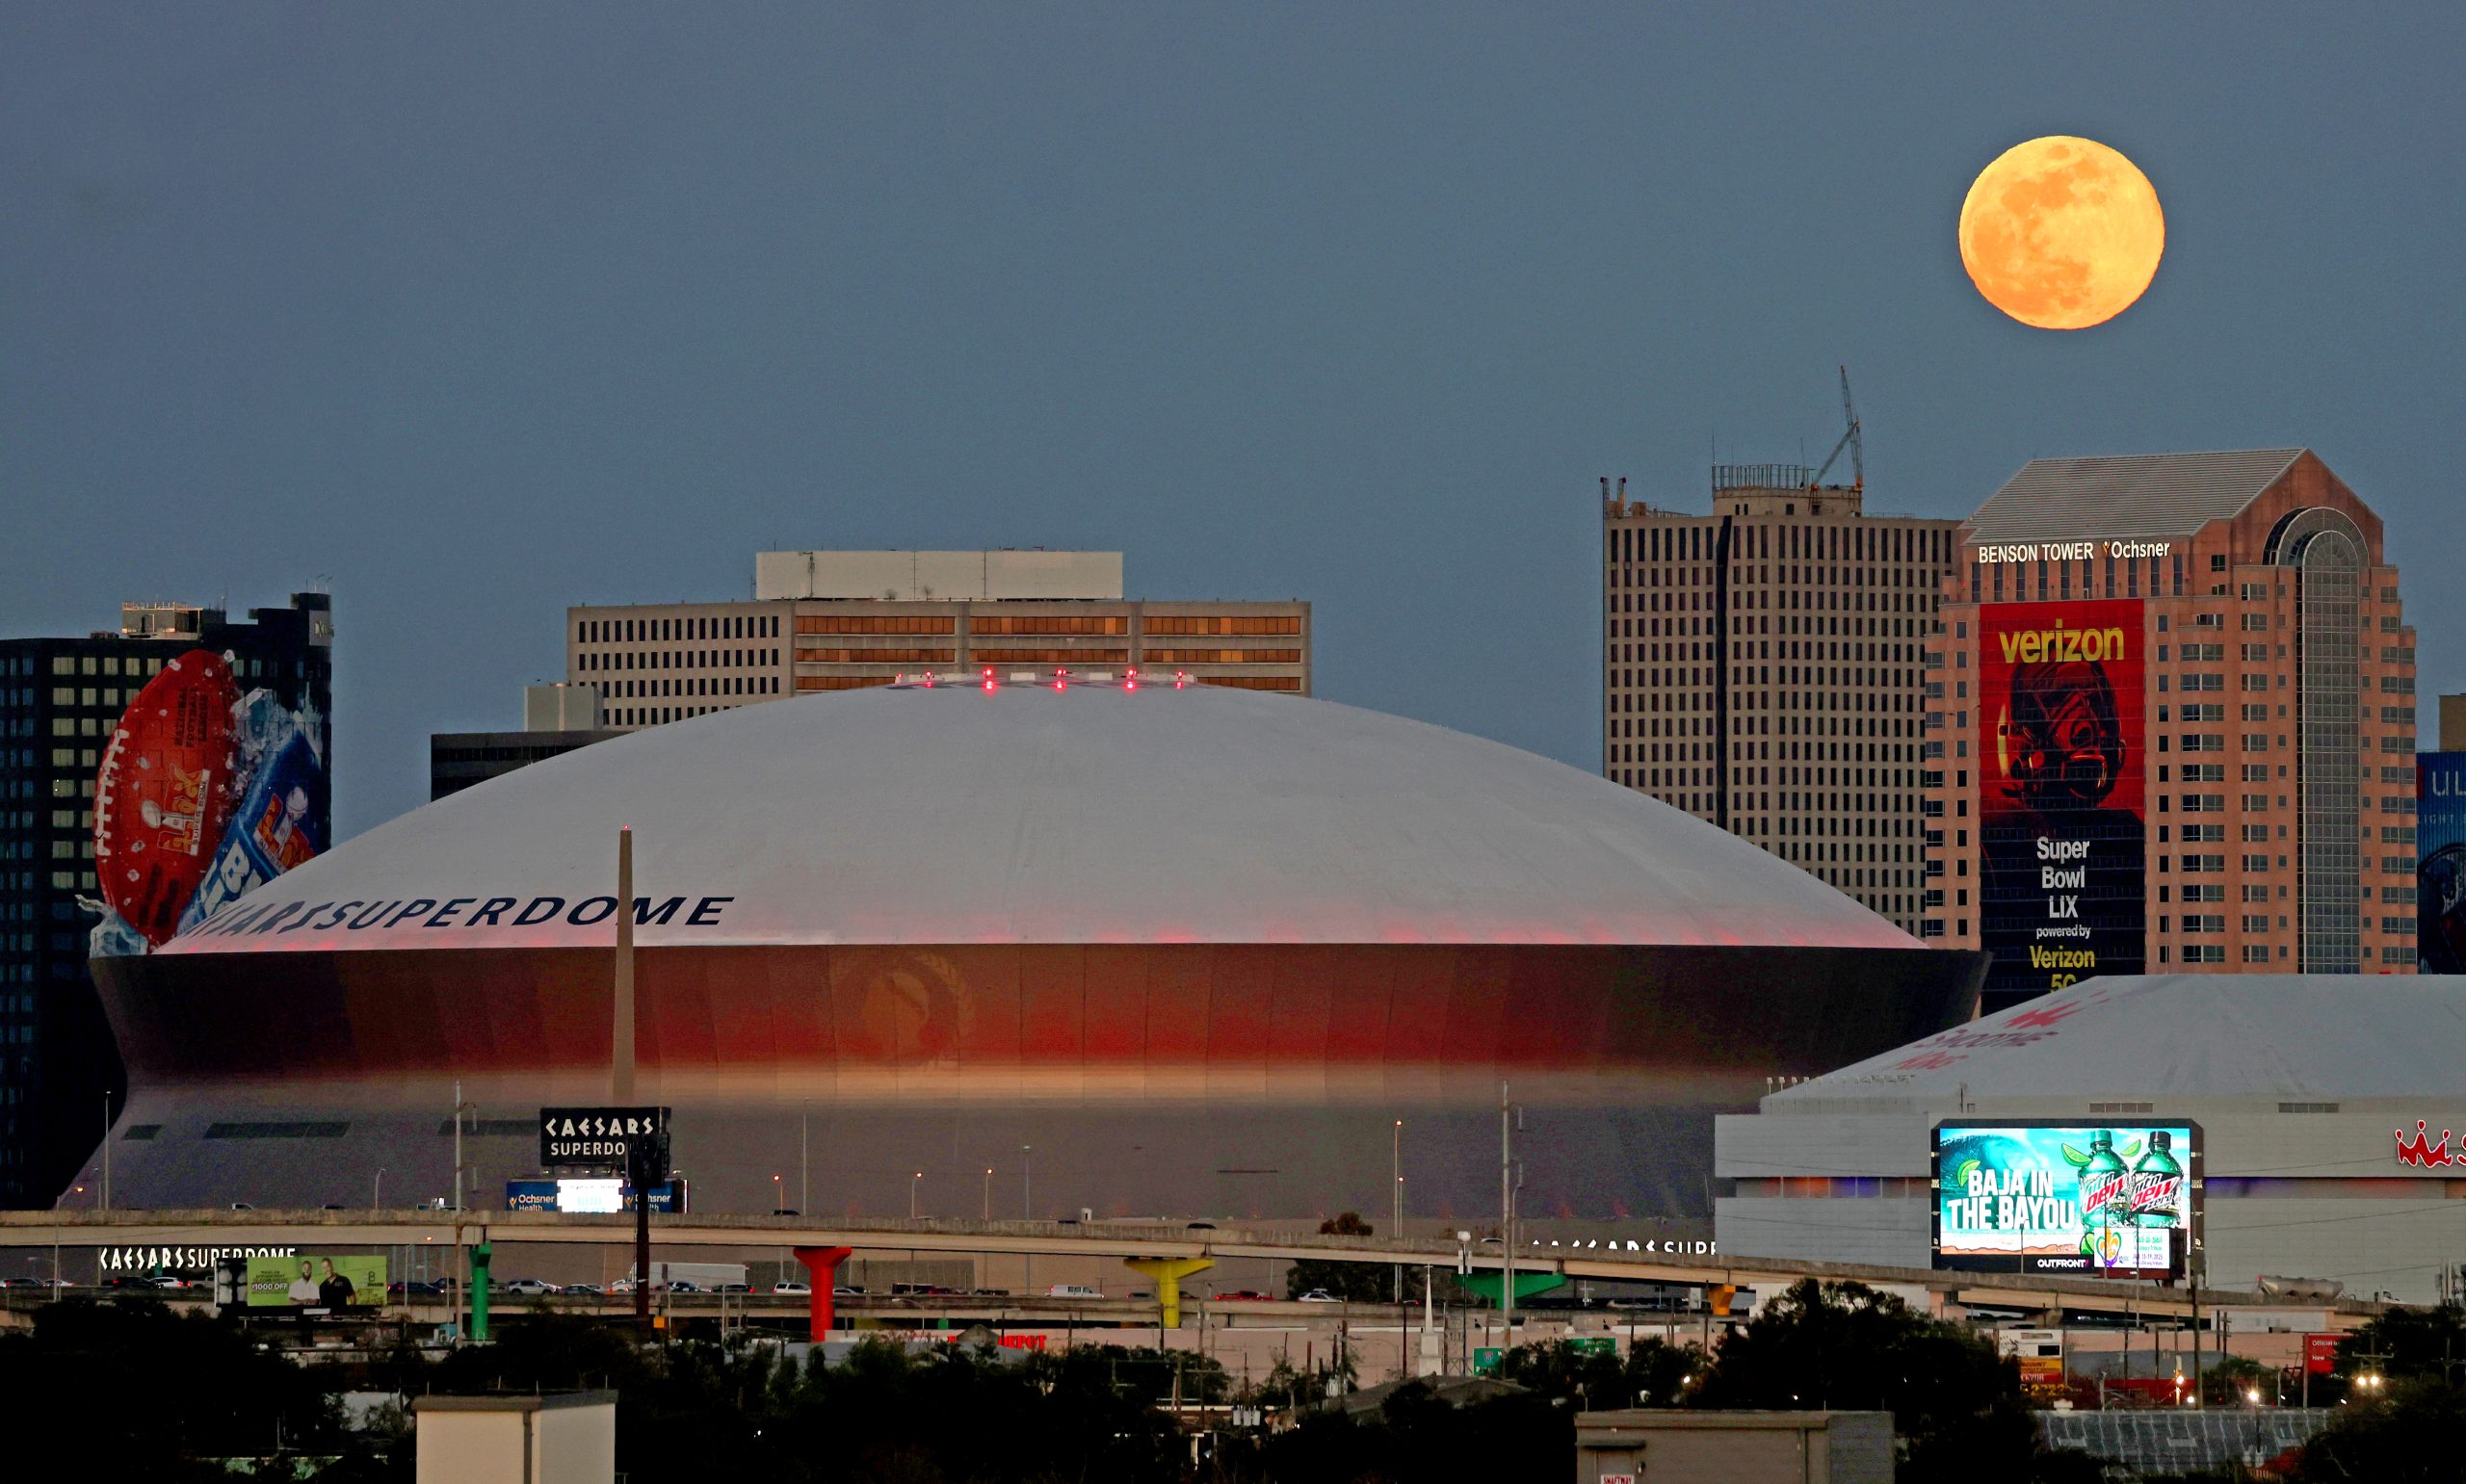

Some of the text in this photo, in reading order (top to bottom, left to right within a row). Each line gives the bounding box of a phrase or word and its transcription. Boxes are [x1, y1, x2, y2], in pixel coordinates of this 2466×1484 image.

[1979, 539, 2169, 563] BENSON TOWER Ochsner
[1999, 618, 2124, 664] verizon
[2036, 836, 2090, 864] Super
[2041, 866, 2086, 888] Bowl
[2049, 895, 2078, 918] LIX
[2036, 924, 2091, 940] powered by
[2030, 945, 2095, 969] Verizon
[545, 1117, 654, 1137] CAESARS
[1968, 1170, 2054, 1197] BAJA IN
[518, 1193, 555, 1204] Ochsner
[1947, 1198, 1998, 1230] THE
[1999, 1198, 2076, 1230] BAYOU
[100, 1246, 184, 1270] CAESARS
[2037, 1259, 2085, 1269] OUTFRONT
